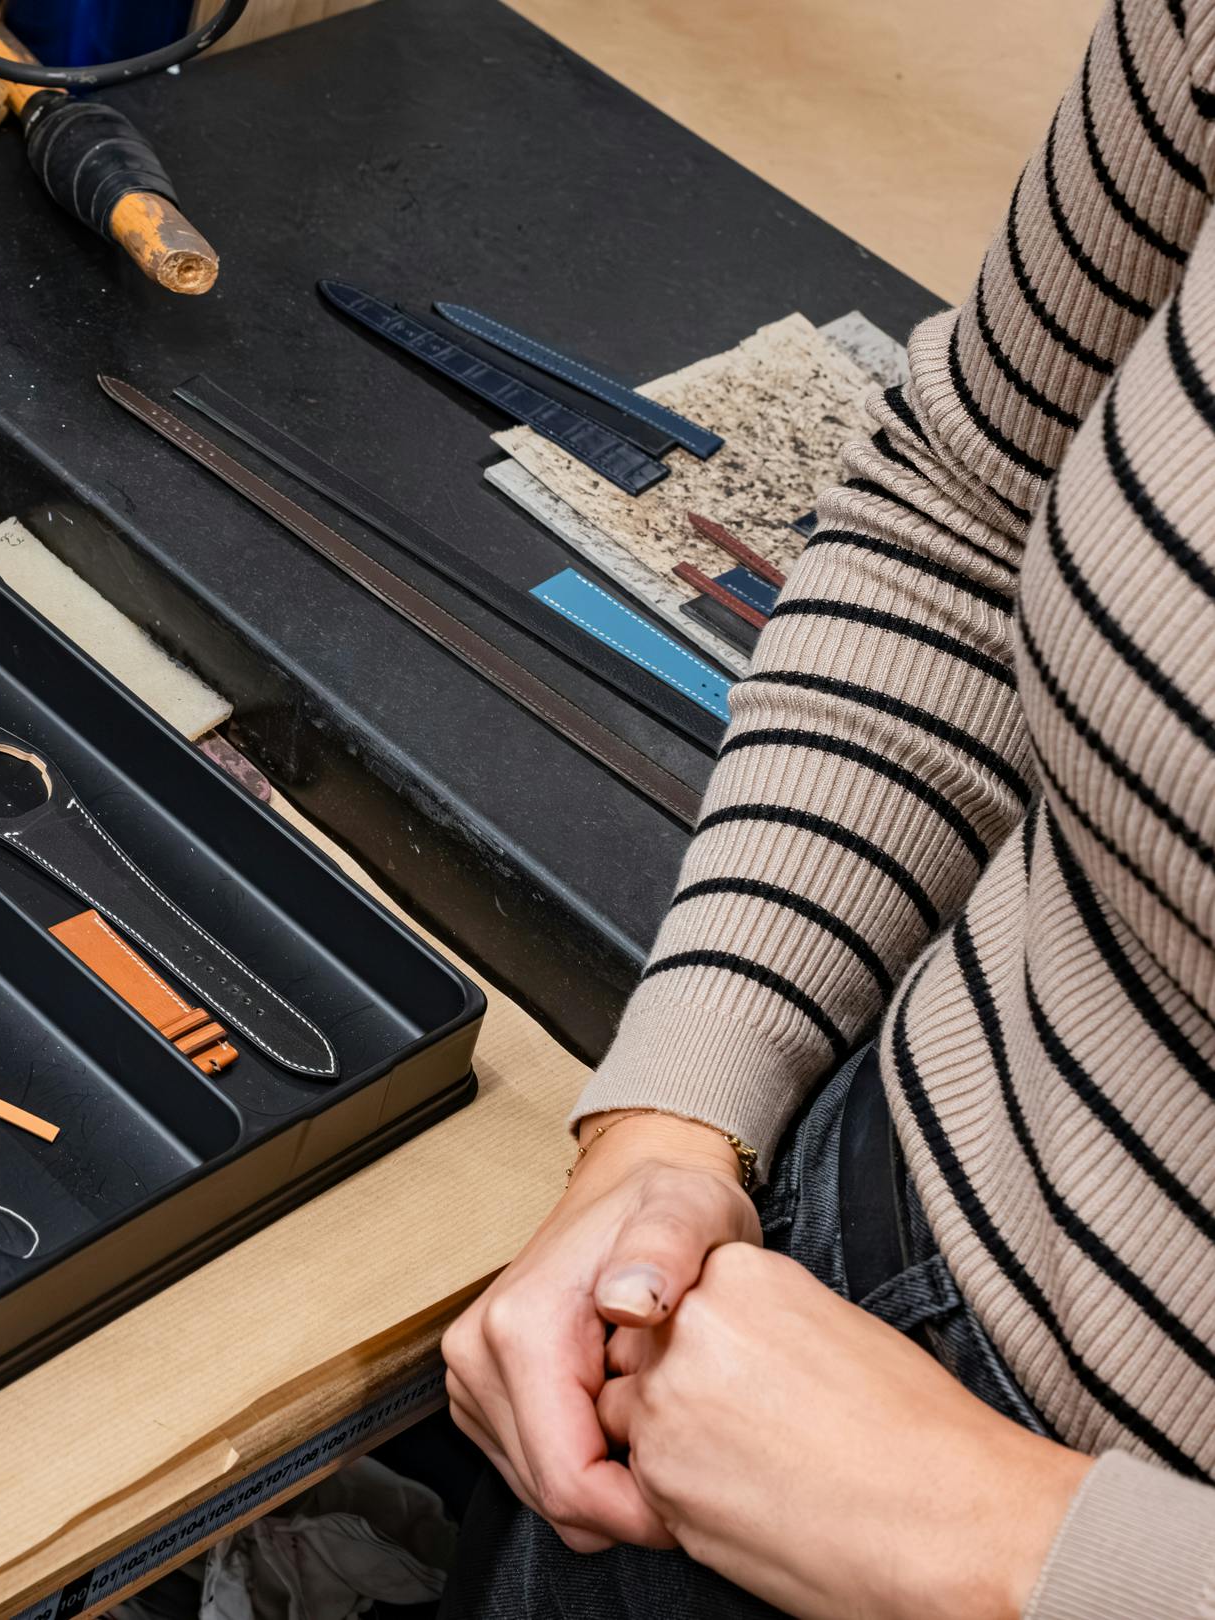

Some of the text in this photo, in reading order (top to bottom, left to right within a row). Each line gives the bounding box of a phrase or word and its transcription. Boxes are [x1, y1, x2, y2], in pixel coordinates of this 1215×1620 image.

[59, 1586, 88, 1612] 100
[91, 1569, 117, 1593] 101
[121, 1550, 148, 1575] 102
[151, 1533, 178, 1557] 103
[180, 1515, 206, 1539] 104
[209, 1497, 235, 1522] 105
[237, 1481, 264, 1505] 106
[265, 1464, 293, 1487] 107
[294, 1447, 320, 1470] 108
[321, 1431, 348, 1454] 109
[349, 1415, 374, 1437] 110
[377, 1398, 401, 1420] 111
[403, 1383, 428, 1405] 112
